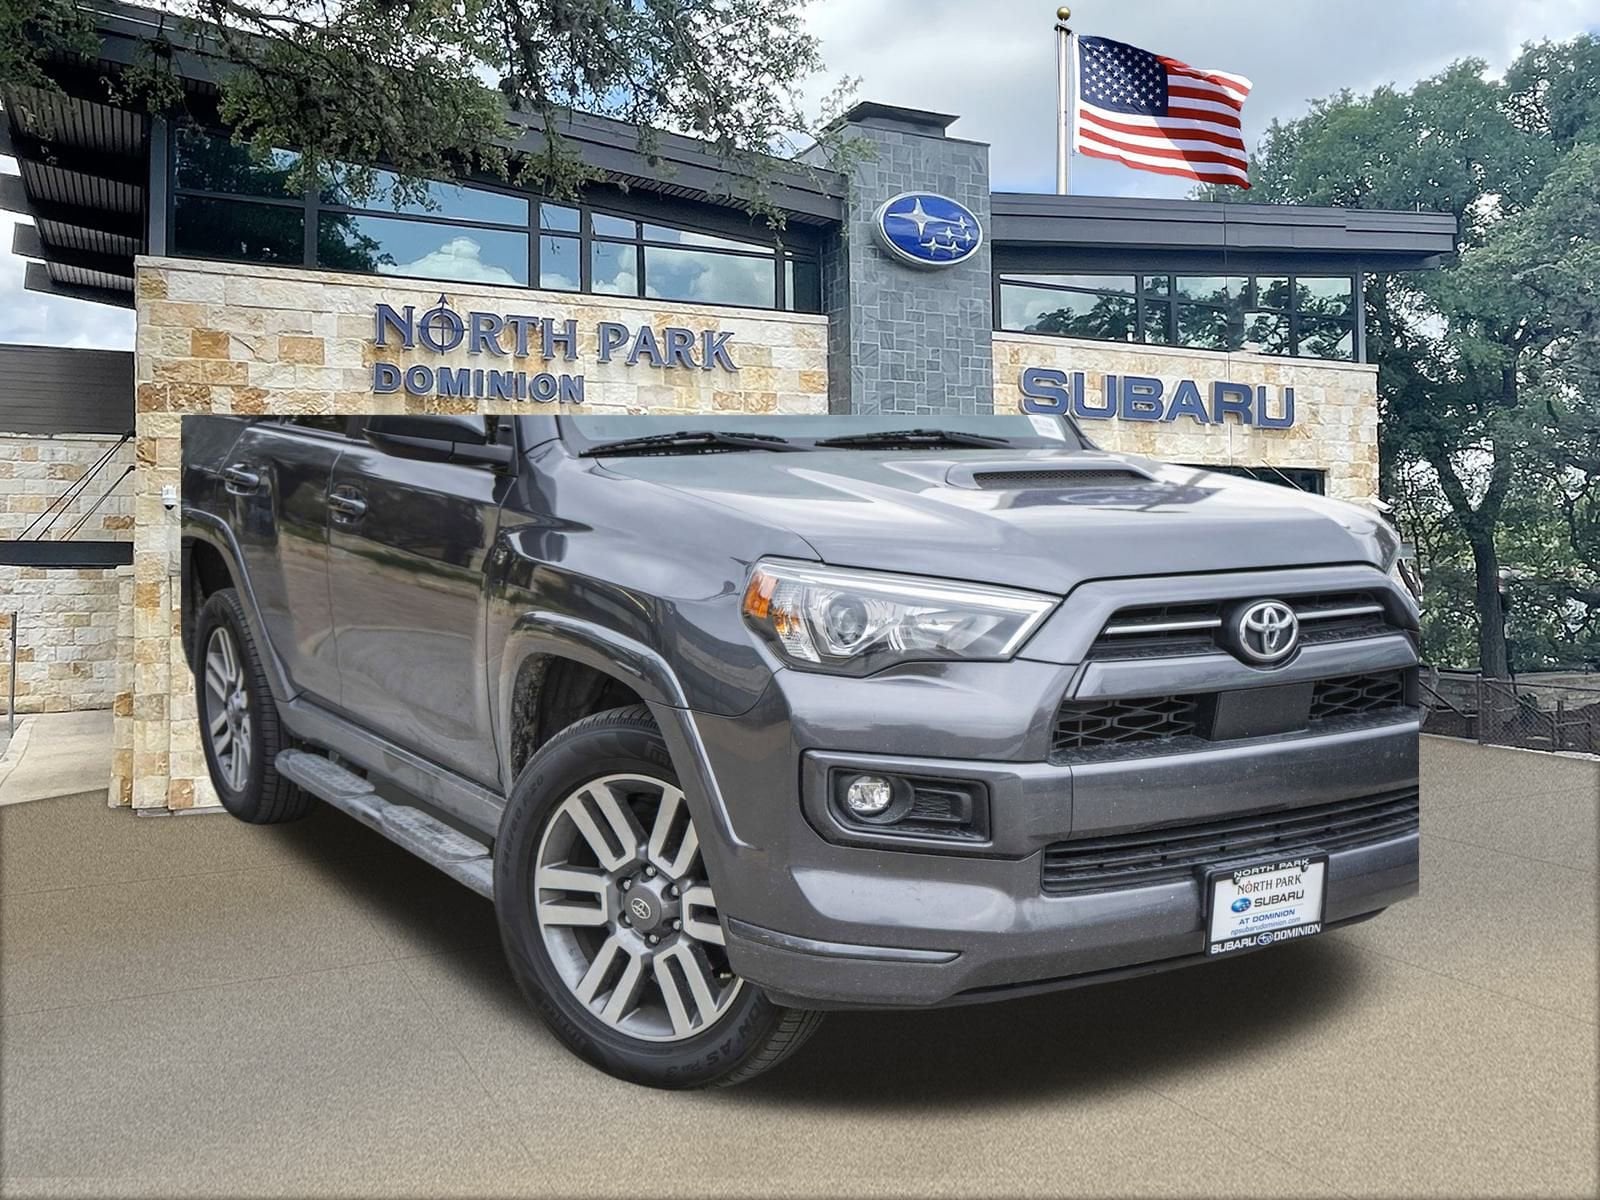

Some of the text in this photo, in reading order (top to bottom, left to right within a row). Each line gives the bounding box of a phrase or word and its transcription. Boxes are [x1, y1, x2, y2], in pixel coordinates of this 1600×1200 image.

[375, 293, 740, 373] NORTH PARK
[373, 362, 585, 404] DOMINION
[1019, 367, 1295, 429] SUBARU
[1233, 858, 1309, 878] NORTH PARK
[1237, 874, 1302, 895] NORTH PARK
[1254, 889, 1304, 908] SUBARU
[1239, 909, 1295, 926] AT DOMINION
[1211, 923, 1321, 954] SUBARU DOMINION
